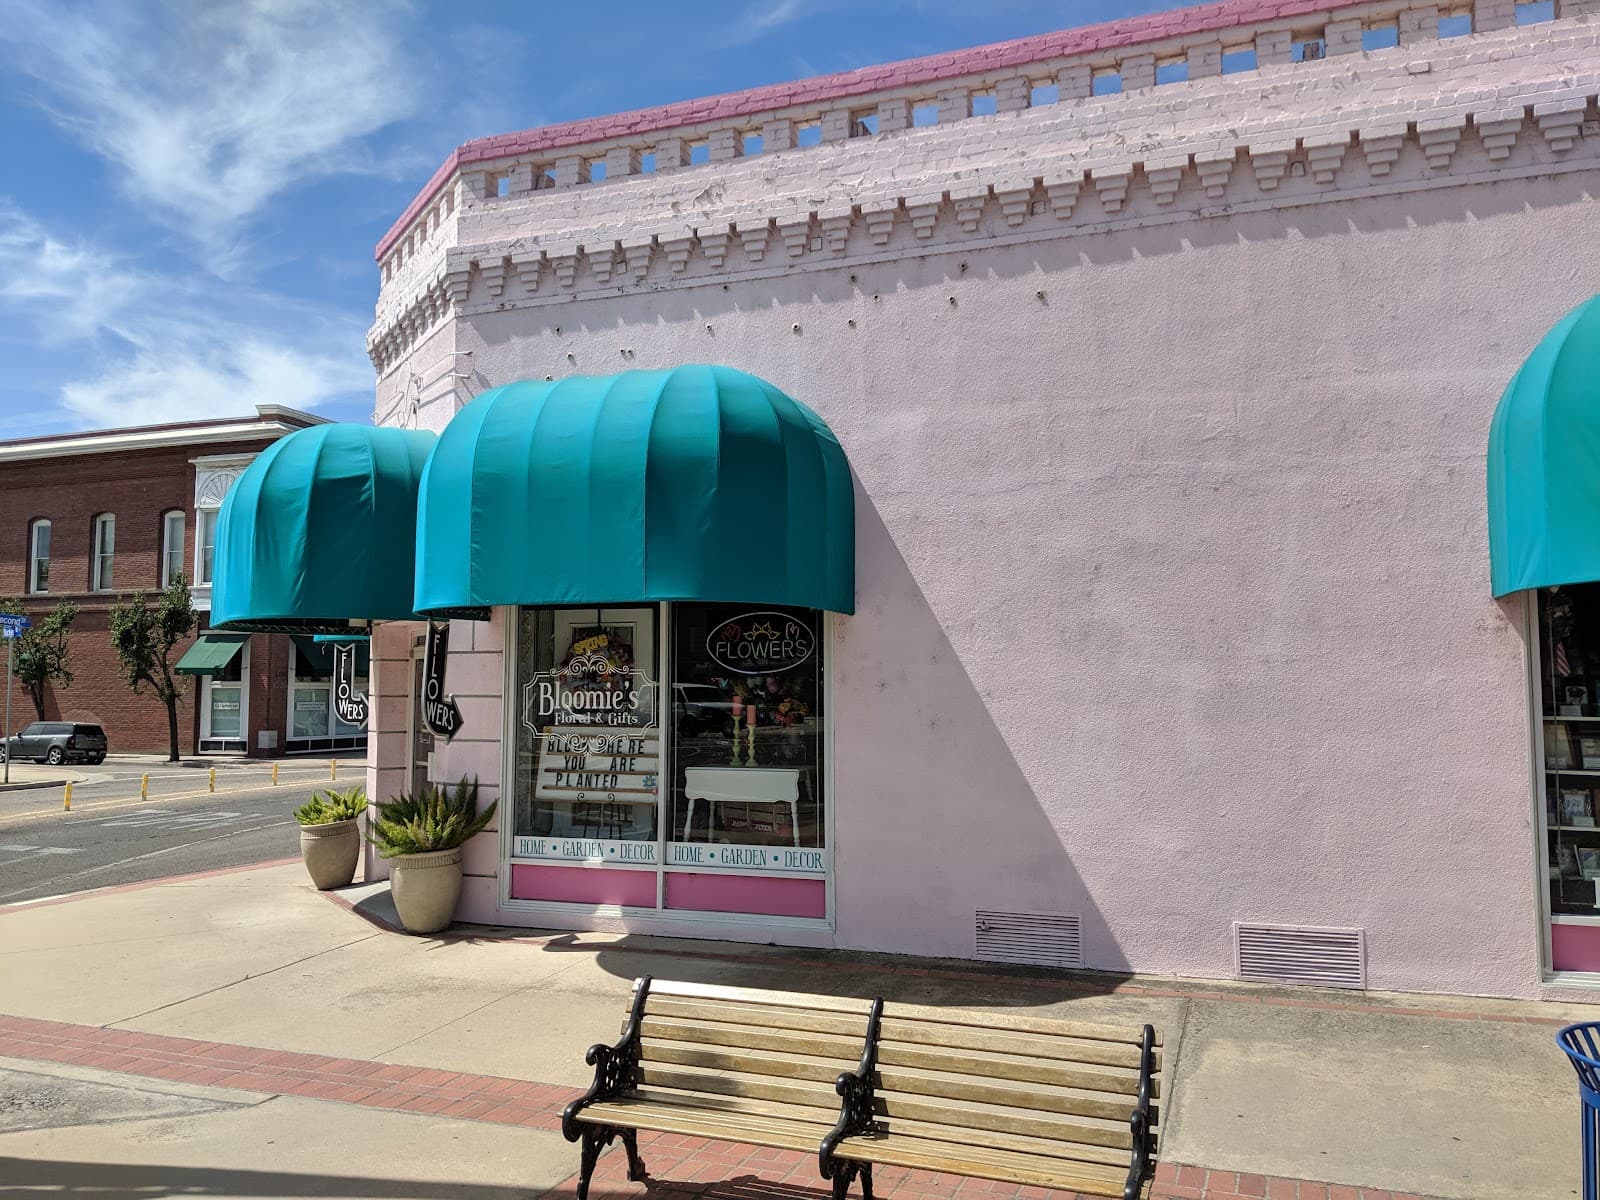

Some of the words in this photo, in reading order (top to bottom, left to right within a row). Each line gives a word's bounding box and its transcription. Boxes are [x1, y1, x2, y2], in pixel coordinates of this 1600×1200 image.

[715, 639, 808, 660] FLOWERS
[538, 680, 640, 716] Bloomie's
[554, 711, 592, 726] Floral
[595, 712, 605, 724] &
[607, 712, 639, 726] Gifts
[564, 755, 587, 771] YOU
[609, 757, 637, 772] ARE
[555, 772, 619, 789] PLANTED
[519, 838, 547, 855] HOME
[562, 840, 605, 858] GARDEN
[619, 843, 656, 860] DECOR
[673, 845, 705, 863] HOME
[720, 847, 767, 866] GARDEN
[784, 850, 824, 869] DECOR
